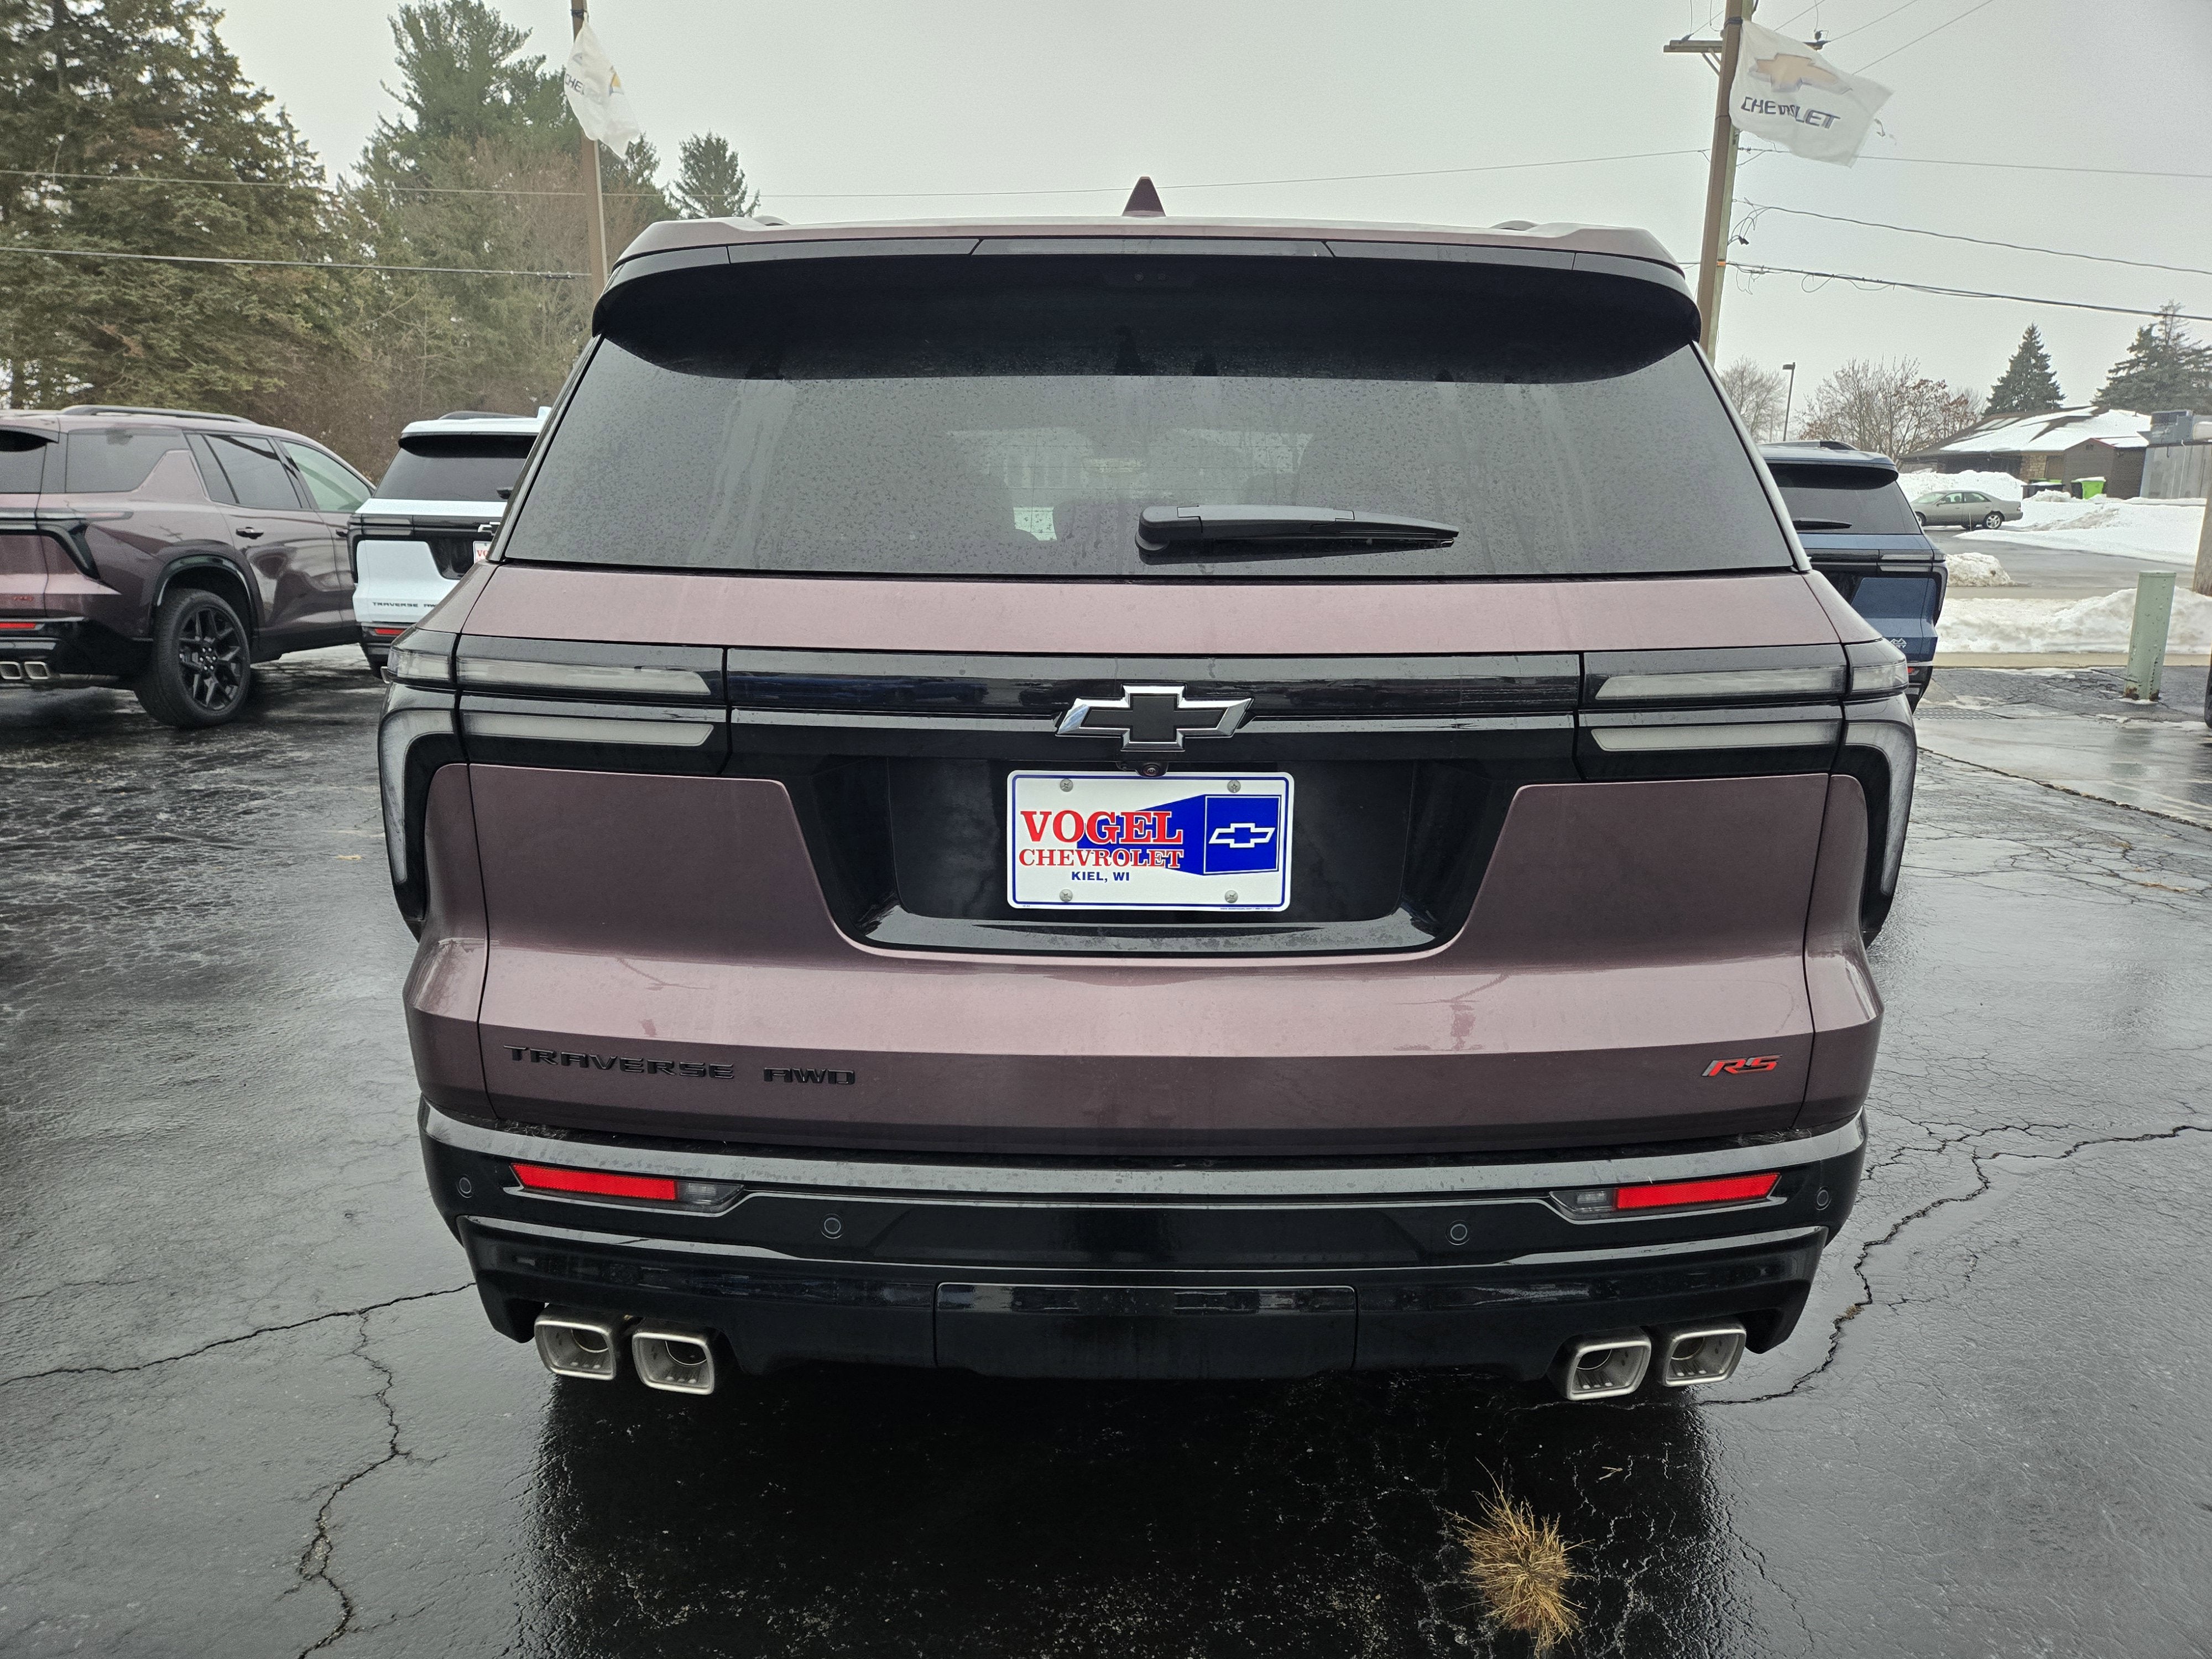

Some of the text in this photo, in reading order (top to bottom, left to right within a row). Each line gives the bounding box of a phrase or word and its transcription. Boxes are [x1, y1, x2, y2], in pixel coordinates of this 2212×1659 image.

[1020, 810, 1183, 845] VOGEL
[1019, 848, 1184, 868] CHEVROLET
[1071, 871, 1130, 883] KIEL, WI
[503, 1045, 855, 1085] TRAVERSE AWD
[1701, 1054, 1783, 1077] RS
